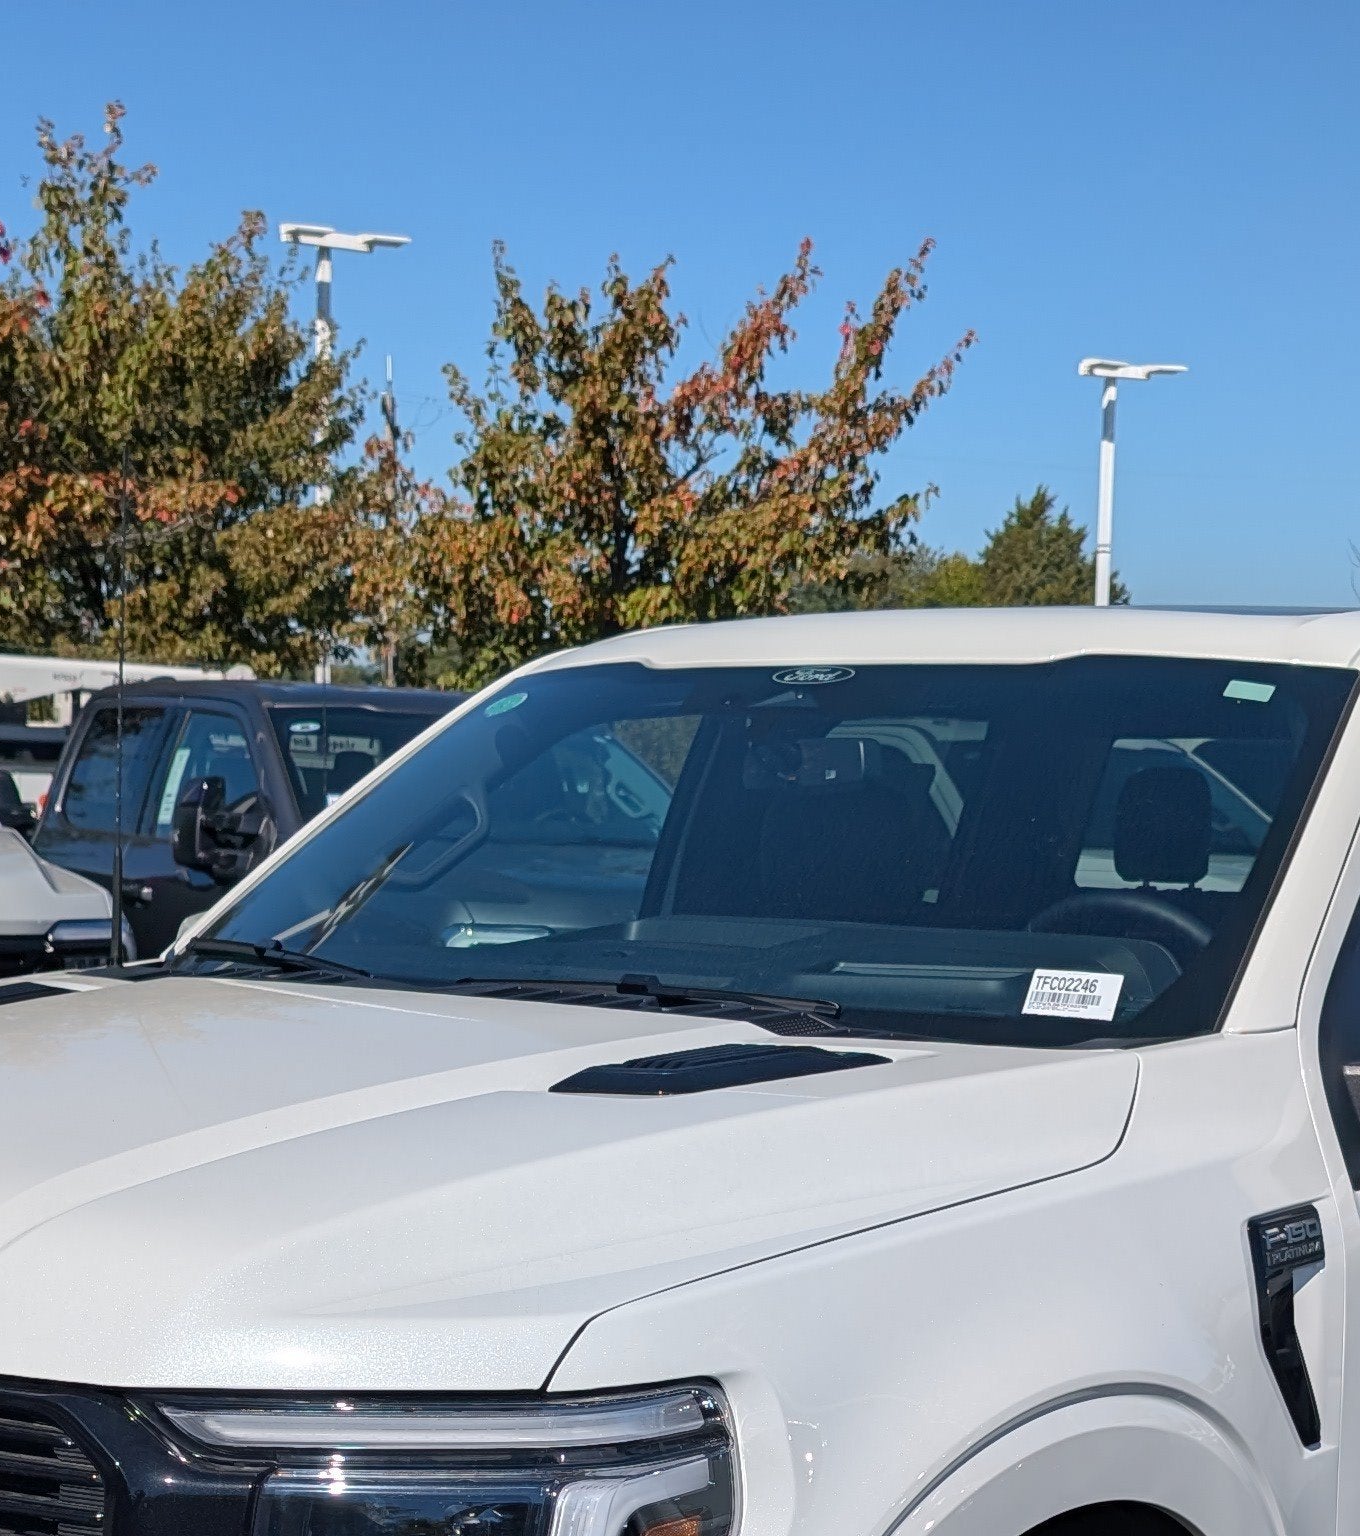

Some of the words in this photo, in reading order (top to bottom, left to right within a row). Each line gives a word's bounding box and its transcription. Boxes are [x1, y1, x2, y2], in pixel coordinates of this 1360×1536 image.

[784, 667, 842, 681] Ford
[1035, 976, 1099, 993] TFC02246
[1262, 1219, 1321, 1250] F-150
[1271, 1241, 1321, 1265] PLATINUM
